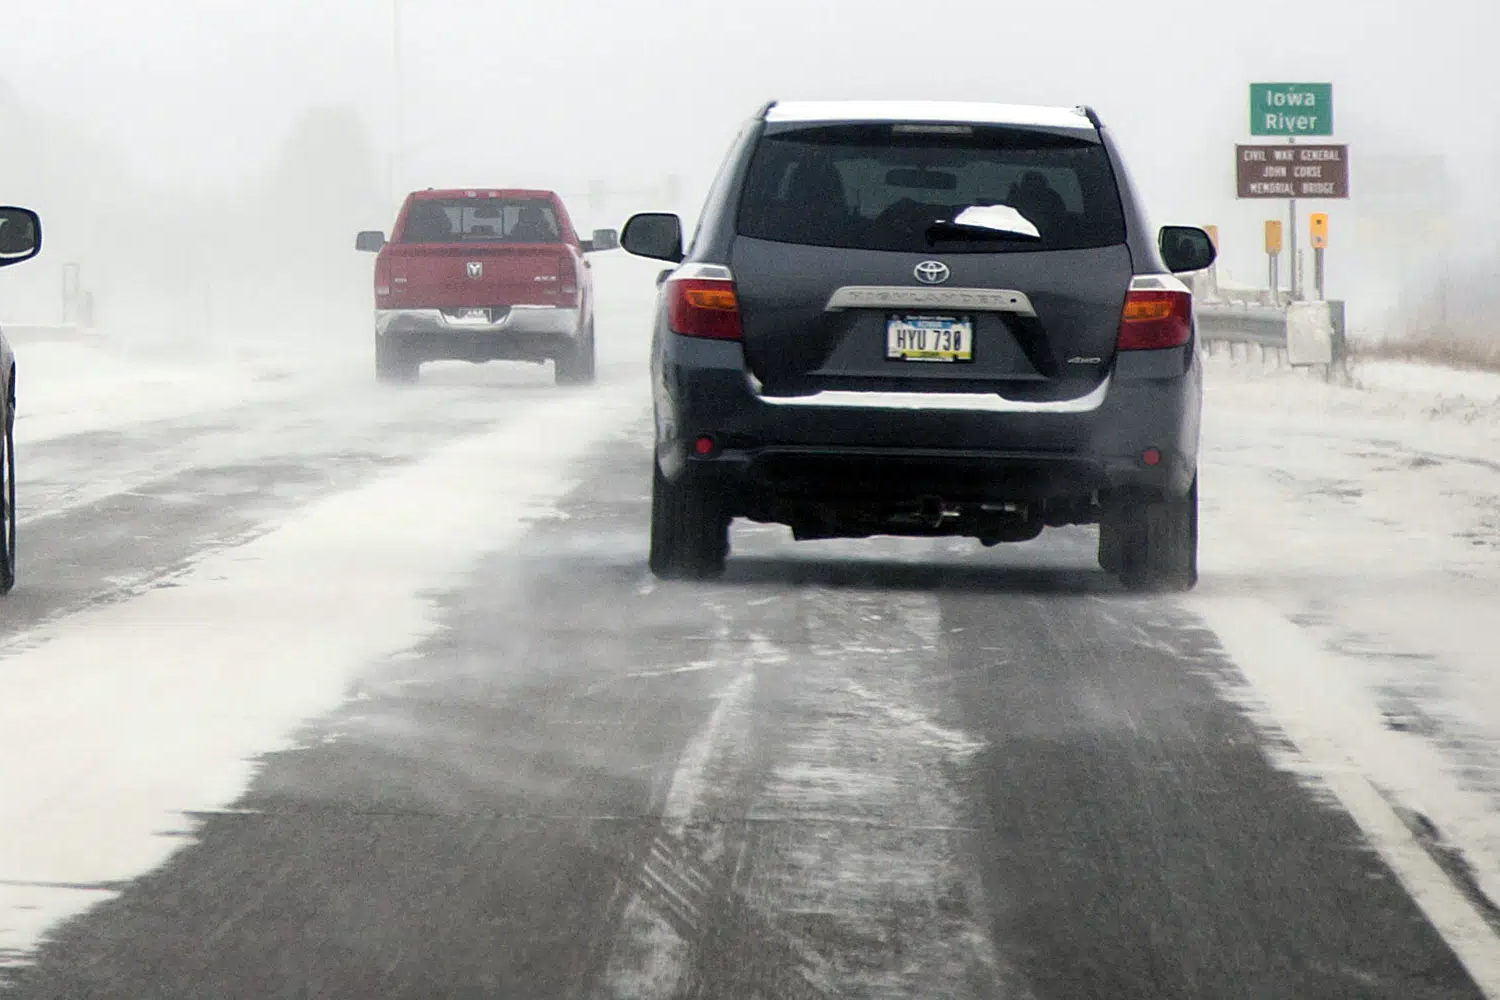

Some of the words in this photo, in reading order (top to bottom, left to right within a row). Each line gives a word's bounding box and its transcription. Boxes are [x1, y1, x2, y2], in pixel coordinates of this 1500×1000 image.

[1266, 90, 1316, 106] Iowa
[1265, 113, 1317, 130] River
[1244, 150, 1266, 161] CIVIL
[1274, 150, 1295, 161] WAR
[1300, 149, 1340, 161] GENERAL
[1263, 166, 1287, 178] JOHN
[1250, 182, 1295, 194] MEMORIAL
[1303, 182, 1336, 194] BRIDGE
[897, 330, 926, 350] HYU
[932, 330, 961, 351] 730
